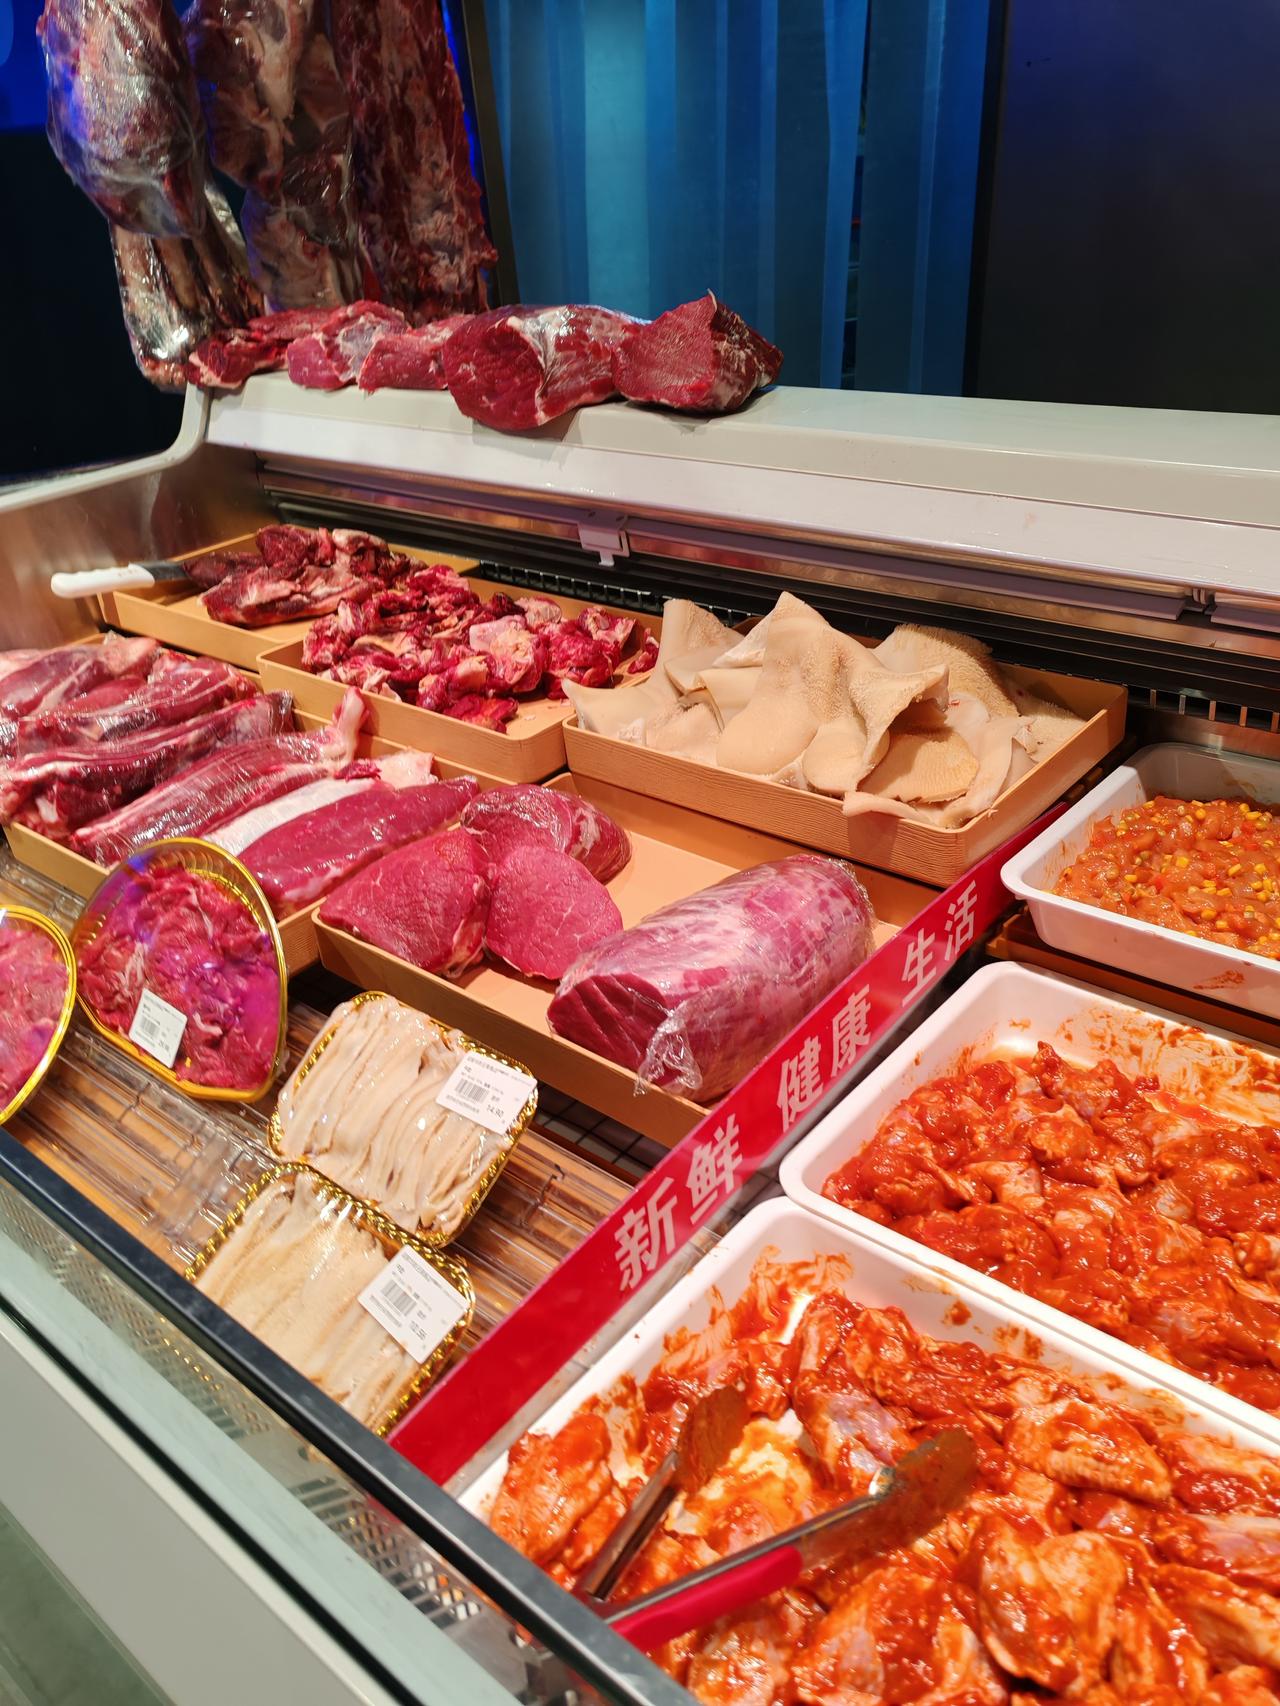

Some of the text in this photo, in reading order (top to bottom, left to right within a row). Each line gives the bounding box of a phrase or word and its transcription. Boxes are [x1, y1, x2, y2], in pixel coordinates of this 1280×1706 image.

[614, 879, 978, 1292] 新鲜 健康 生活
